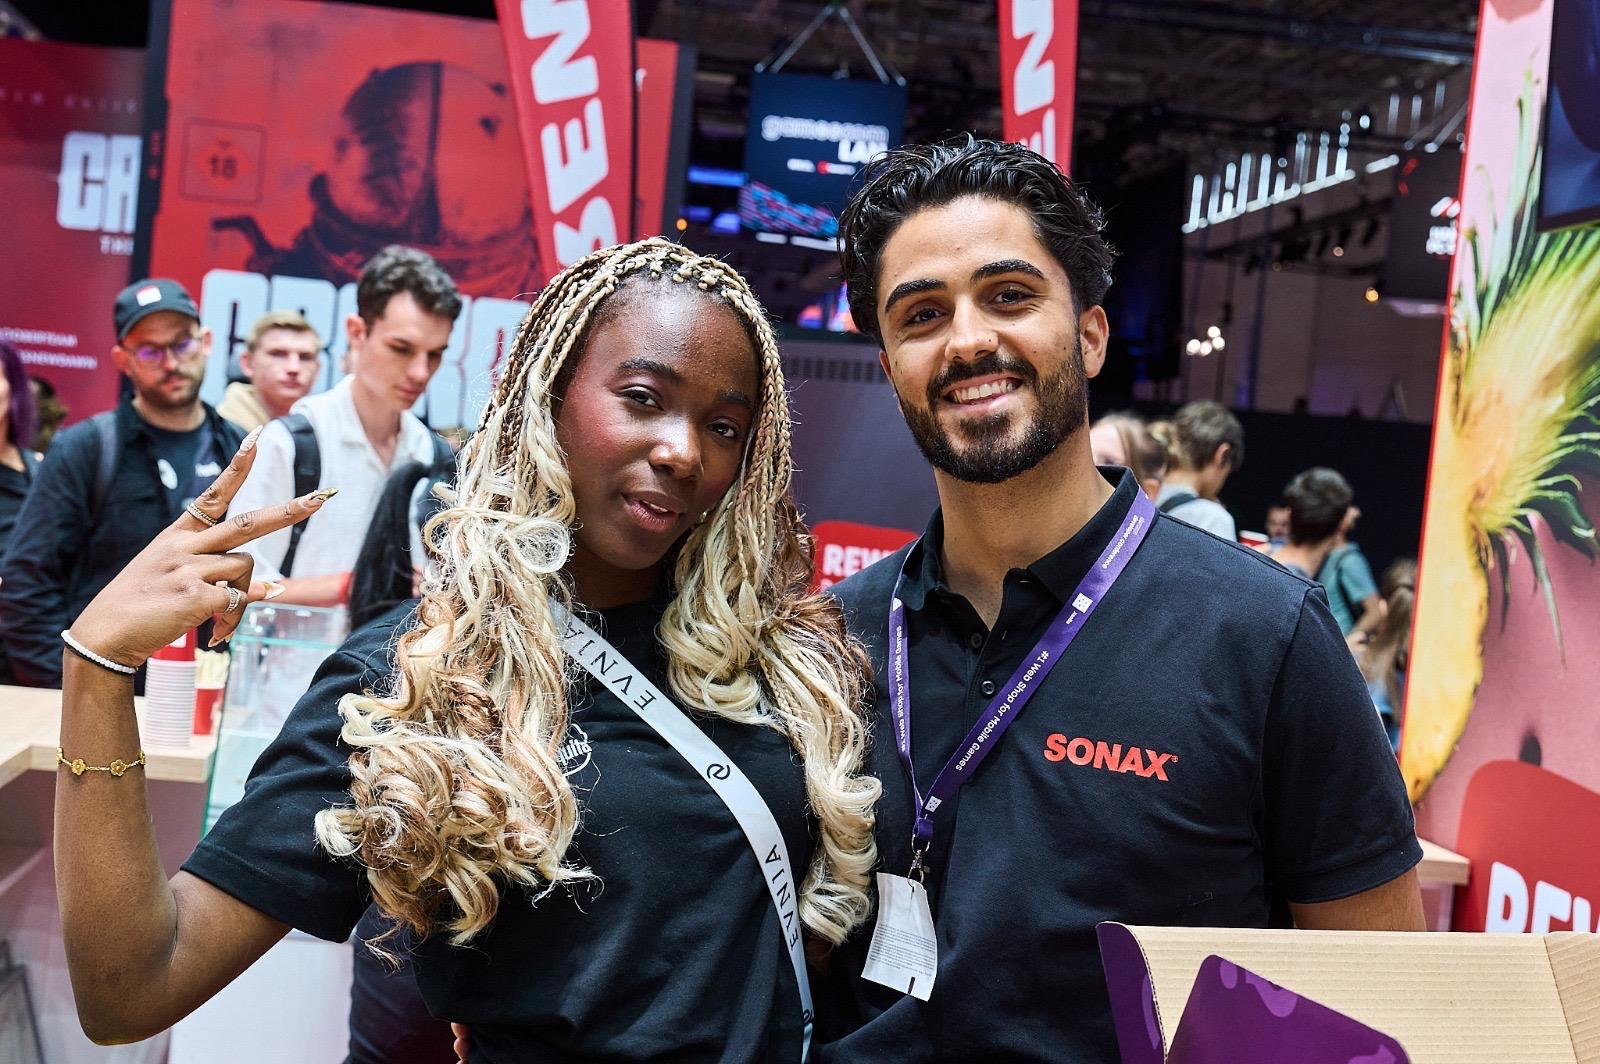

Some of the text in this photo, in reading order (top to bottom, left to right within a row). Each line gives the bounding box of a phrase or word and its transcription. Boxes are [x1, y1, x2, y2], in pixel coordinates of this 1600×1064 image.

[823, 544, 897, 578] REW
[895, 654, 903, 682] Mobile
[955, 650, 1049, 771] #1 Web Shop for Mobile Games
[765, 844, 799, 951] EVNIA
